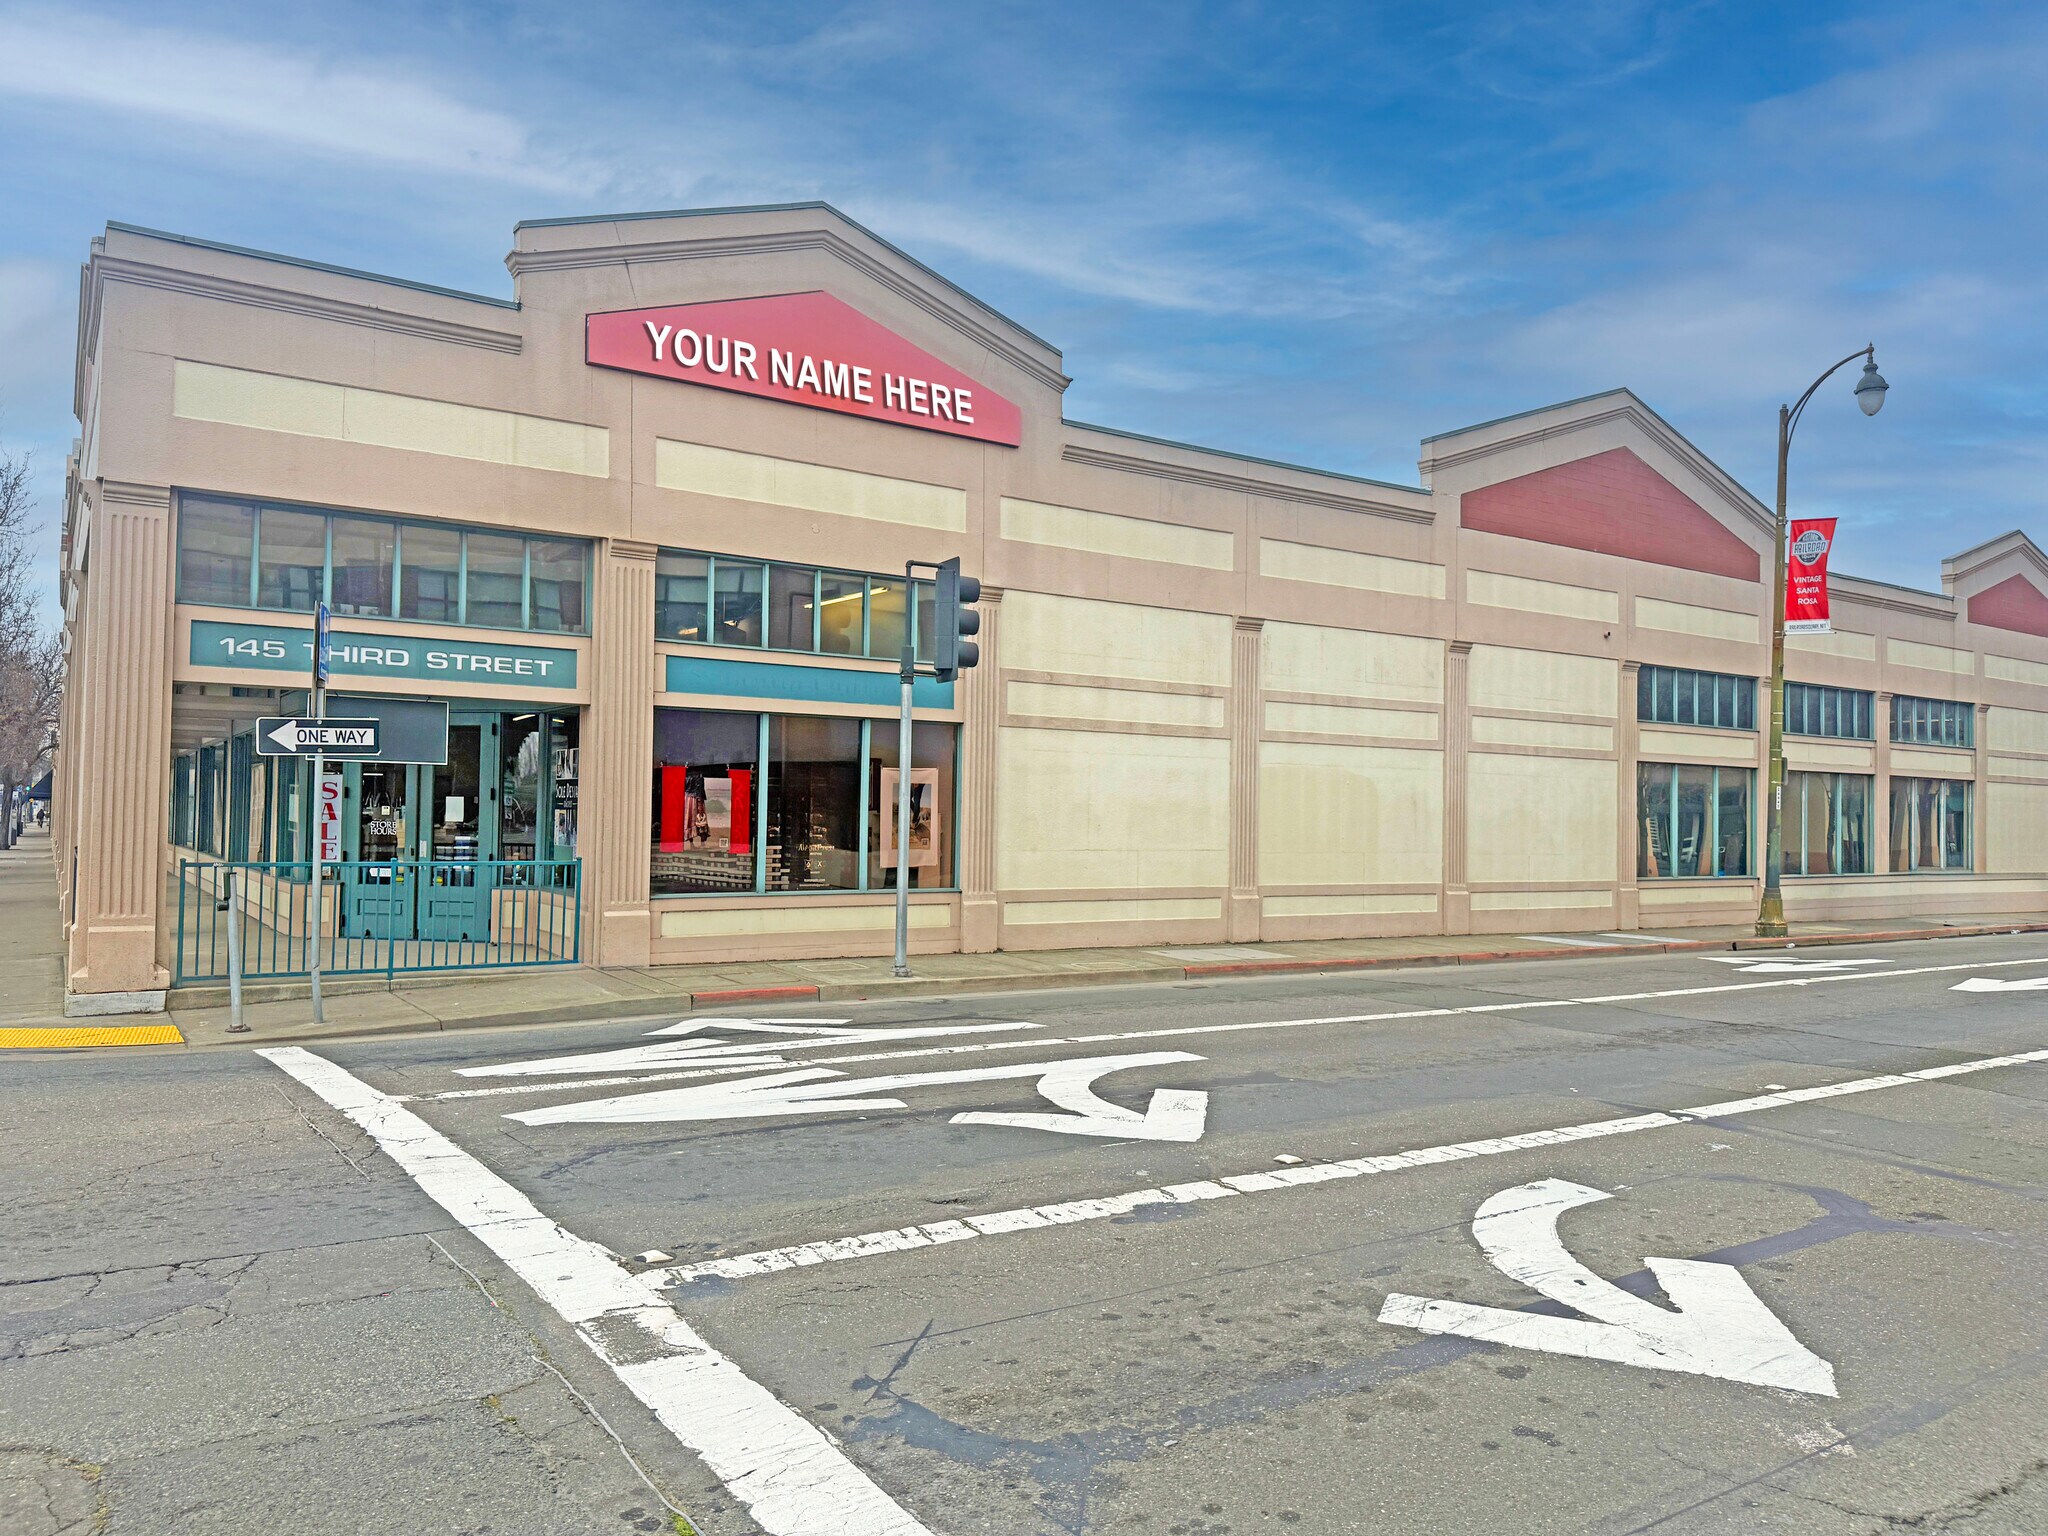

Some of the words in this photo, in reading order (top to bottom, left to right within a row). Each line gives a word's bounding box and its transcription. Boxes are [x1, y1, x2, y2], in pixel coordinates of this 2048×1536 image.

[645, 320, 759, 380] YOUR
[769, 348, 874, 403] NAME
[883, 372, 975, 424] HERE
[1794, 541, 1826, 554] RAILROAD
[219, 637, 286, 659] 145
[303, 642, 410, 667] THIRD
[425, 652, 555, 677] STREET
[297, 729, 329, 744] ONE
[335, 730, 367, 744] WAY
[321, 781, 339, 861] SALE
[370, 820, 397, 828] STORE
[370, 827, 397, 835] HOURS
